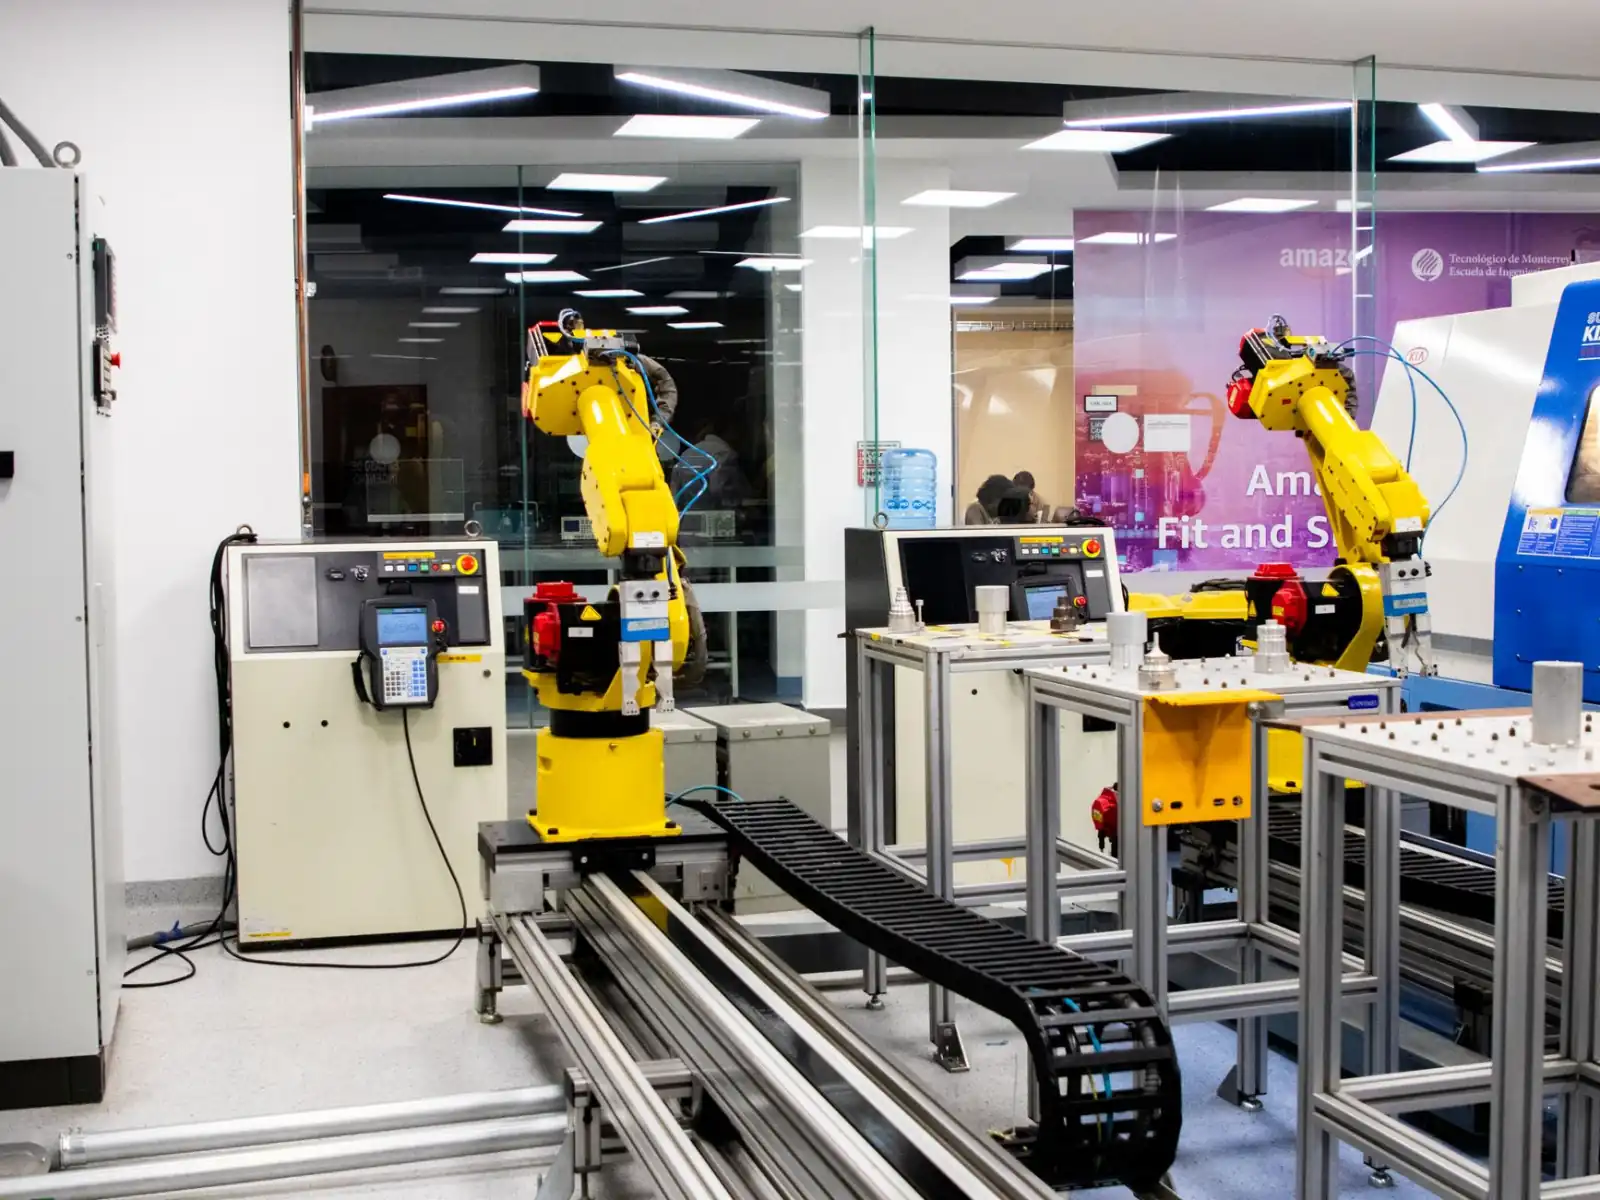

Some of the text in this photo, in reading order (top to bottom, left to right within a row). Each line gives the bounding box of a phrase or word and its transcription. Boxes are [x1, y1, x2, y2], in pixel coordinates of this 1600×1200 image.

[1449, 253, 1571, 266] Tecnológico de Monterrey
[1449, 266, 1484, 277] Escuela
[1486, 266, 1497, 277] de
[1158, 514, 1338, 550] Fit and S
